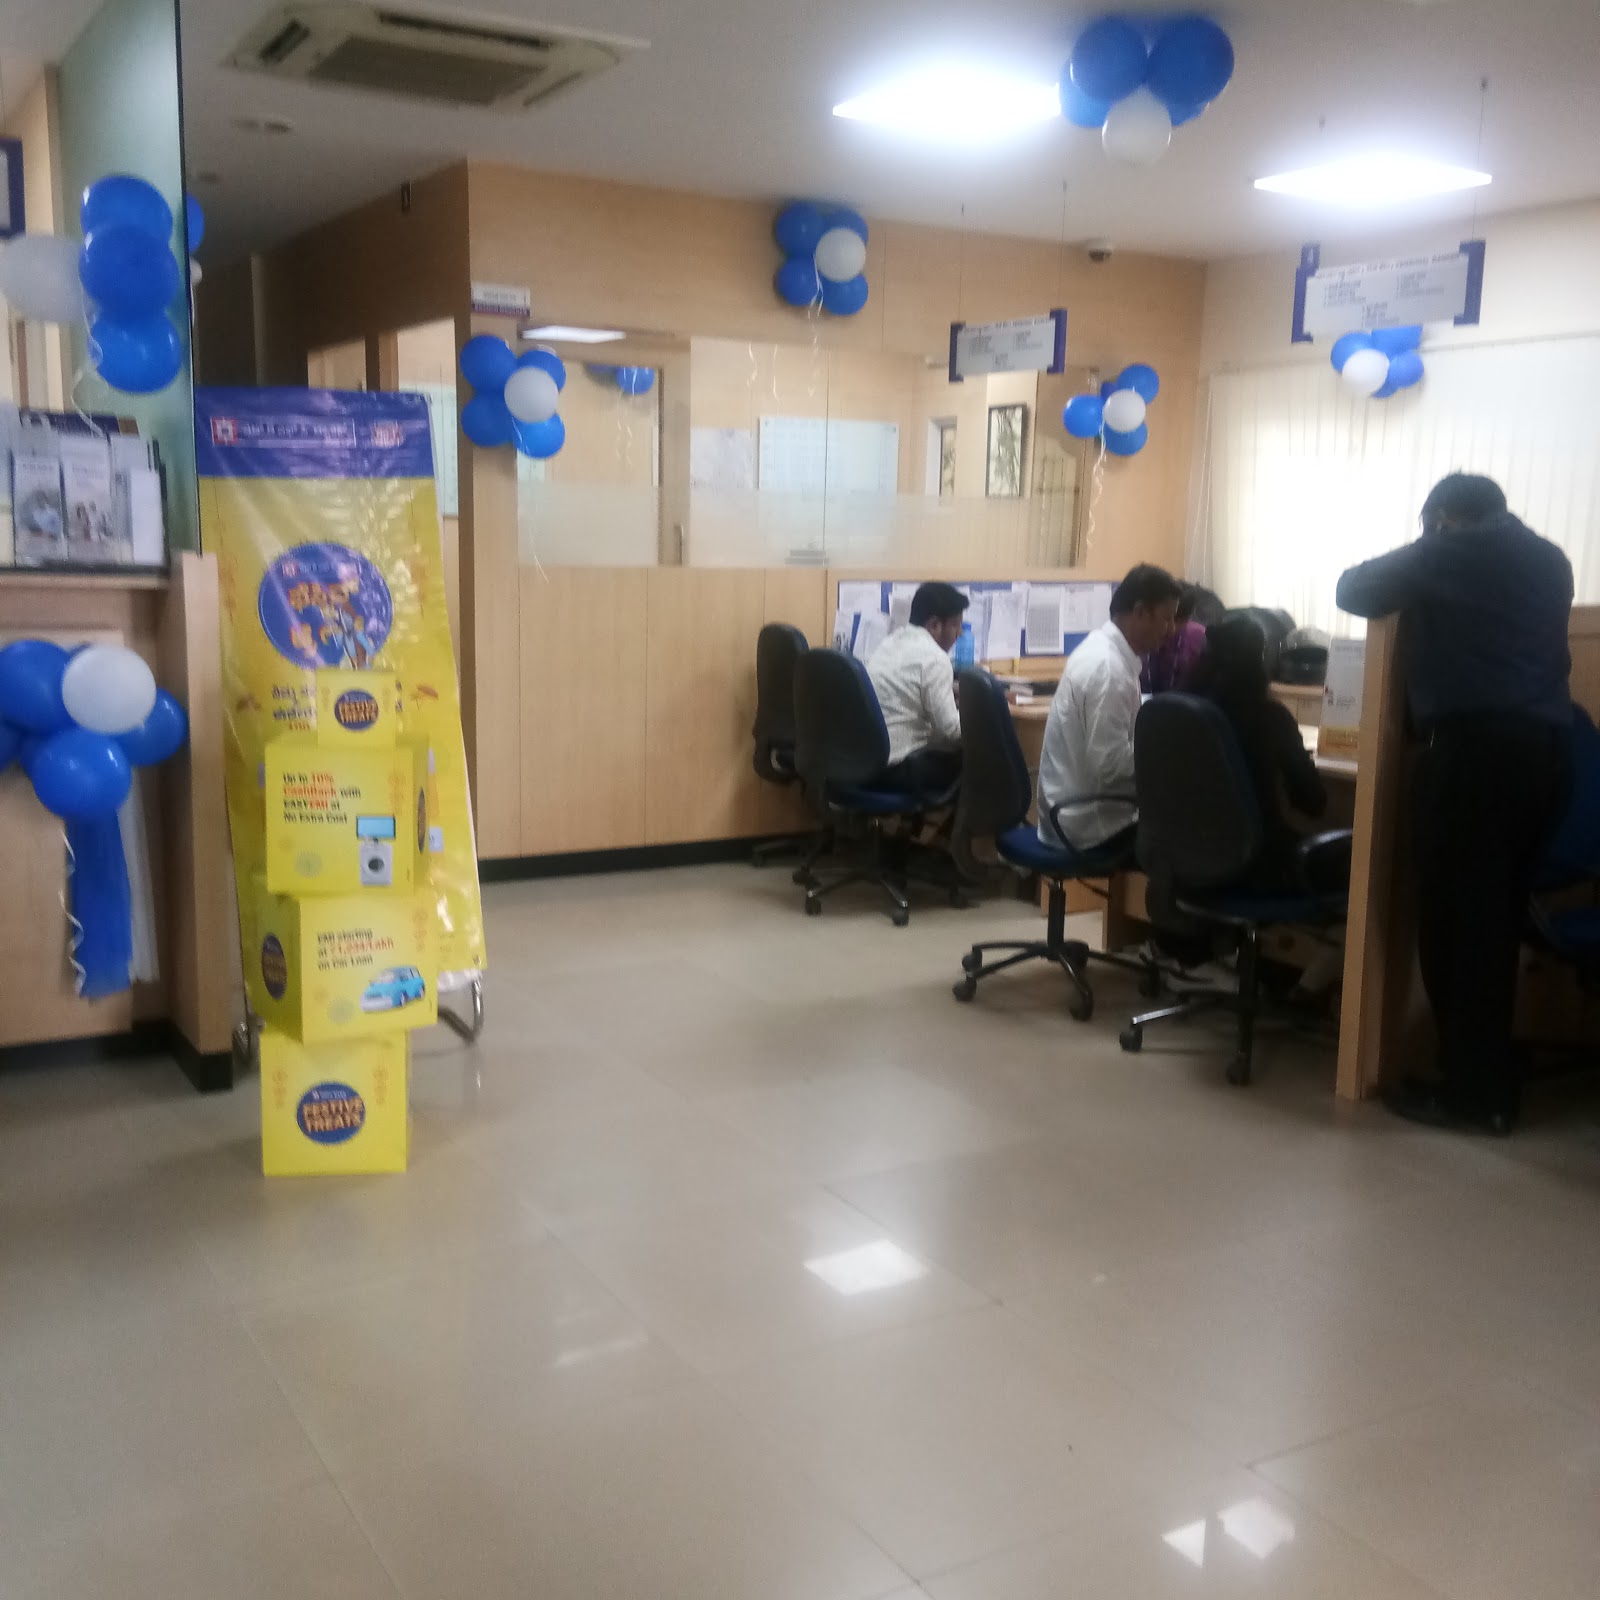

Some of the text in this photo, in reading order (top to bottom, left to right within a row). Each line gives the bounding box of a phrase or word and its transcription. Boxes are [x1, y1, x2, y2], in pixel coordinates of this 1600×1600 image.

[283, 773, 295, 785] Up
[298, 773, 307, 783] to
[340, 785, 361, 797] with
[283, 811, 347, 824] No Extra Cost
[337, 928, 373, 942] starting
[318, 960, 330, 971] on
[350, 954, 373, 966] Loan
[303, 1096, 362, 1115] FESTIVE
[304, 1112, 360, 1132] TREATS
